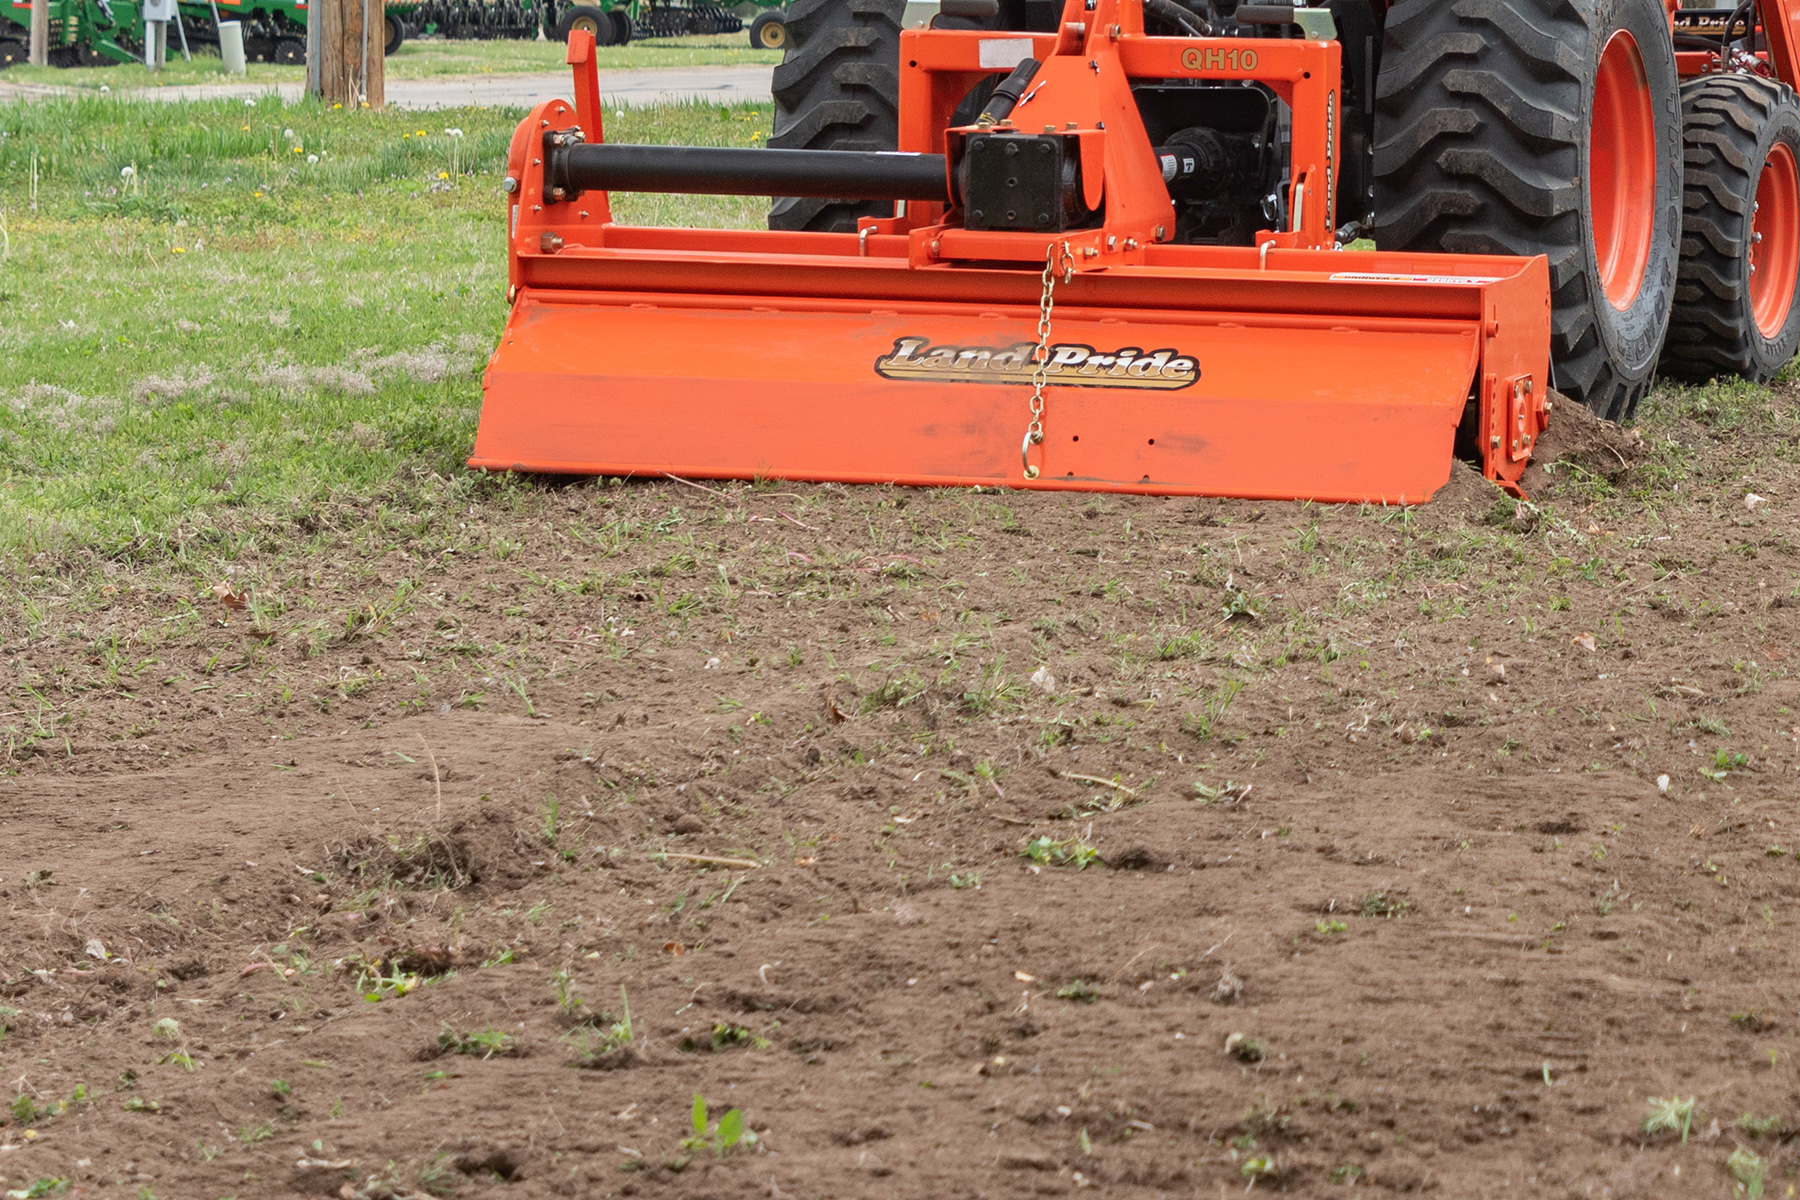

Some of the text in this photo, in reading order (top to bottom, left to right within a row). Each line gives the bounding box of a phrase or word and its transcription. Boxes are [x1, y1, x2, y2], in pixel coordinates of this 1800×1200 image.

[1181, 47, 1258, 71] QH10
[886, 338, 1195, 378] Land Pride
